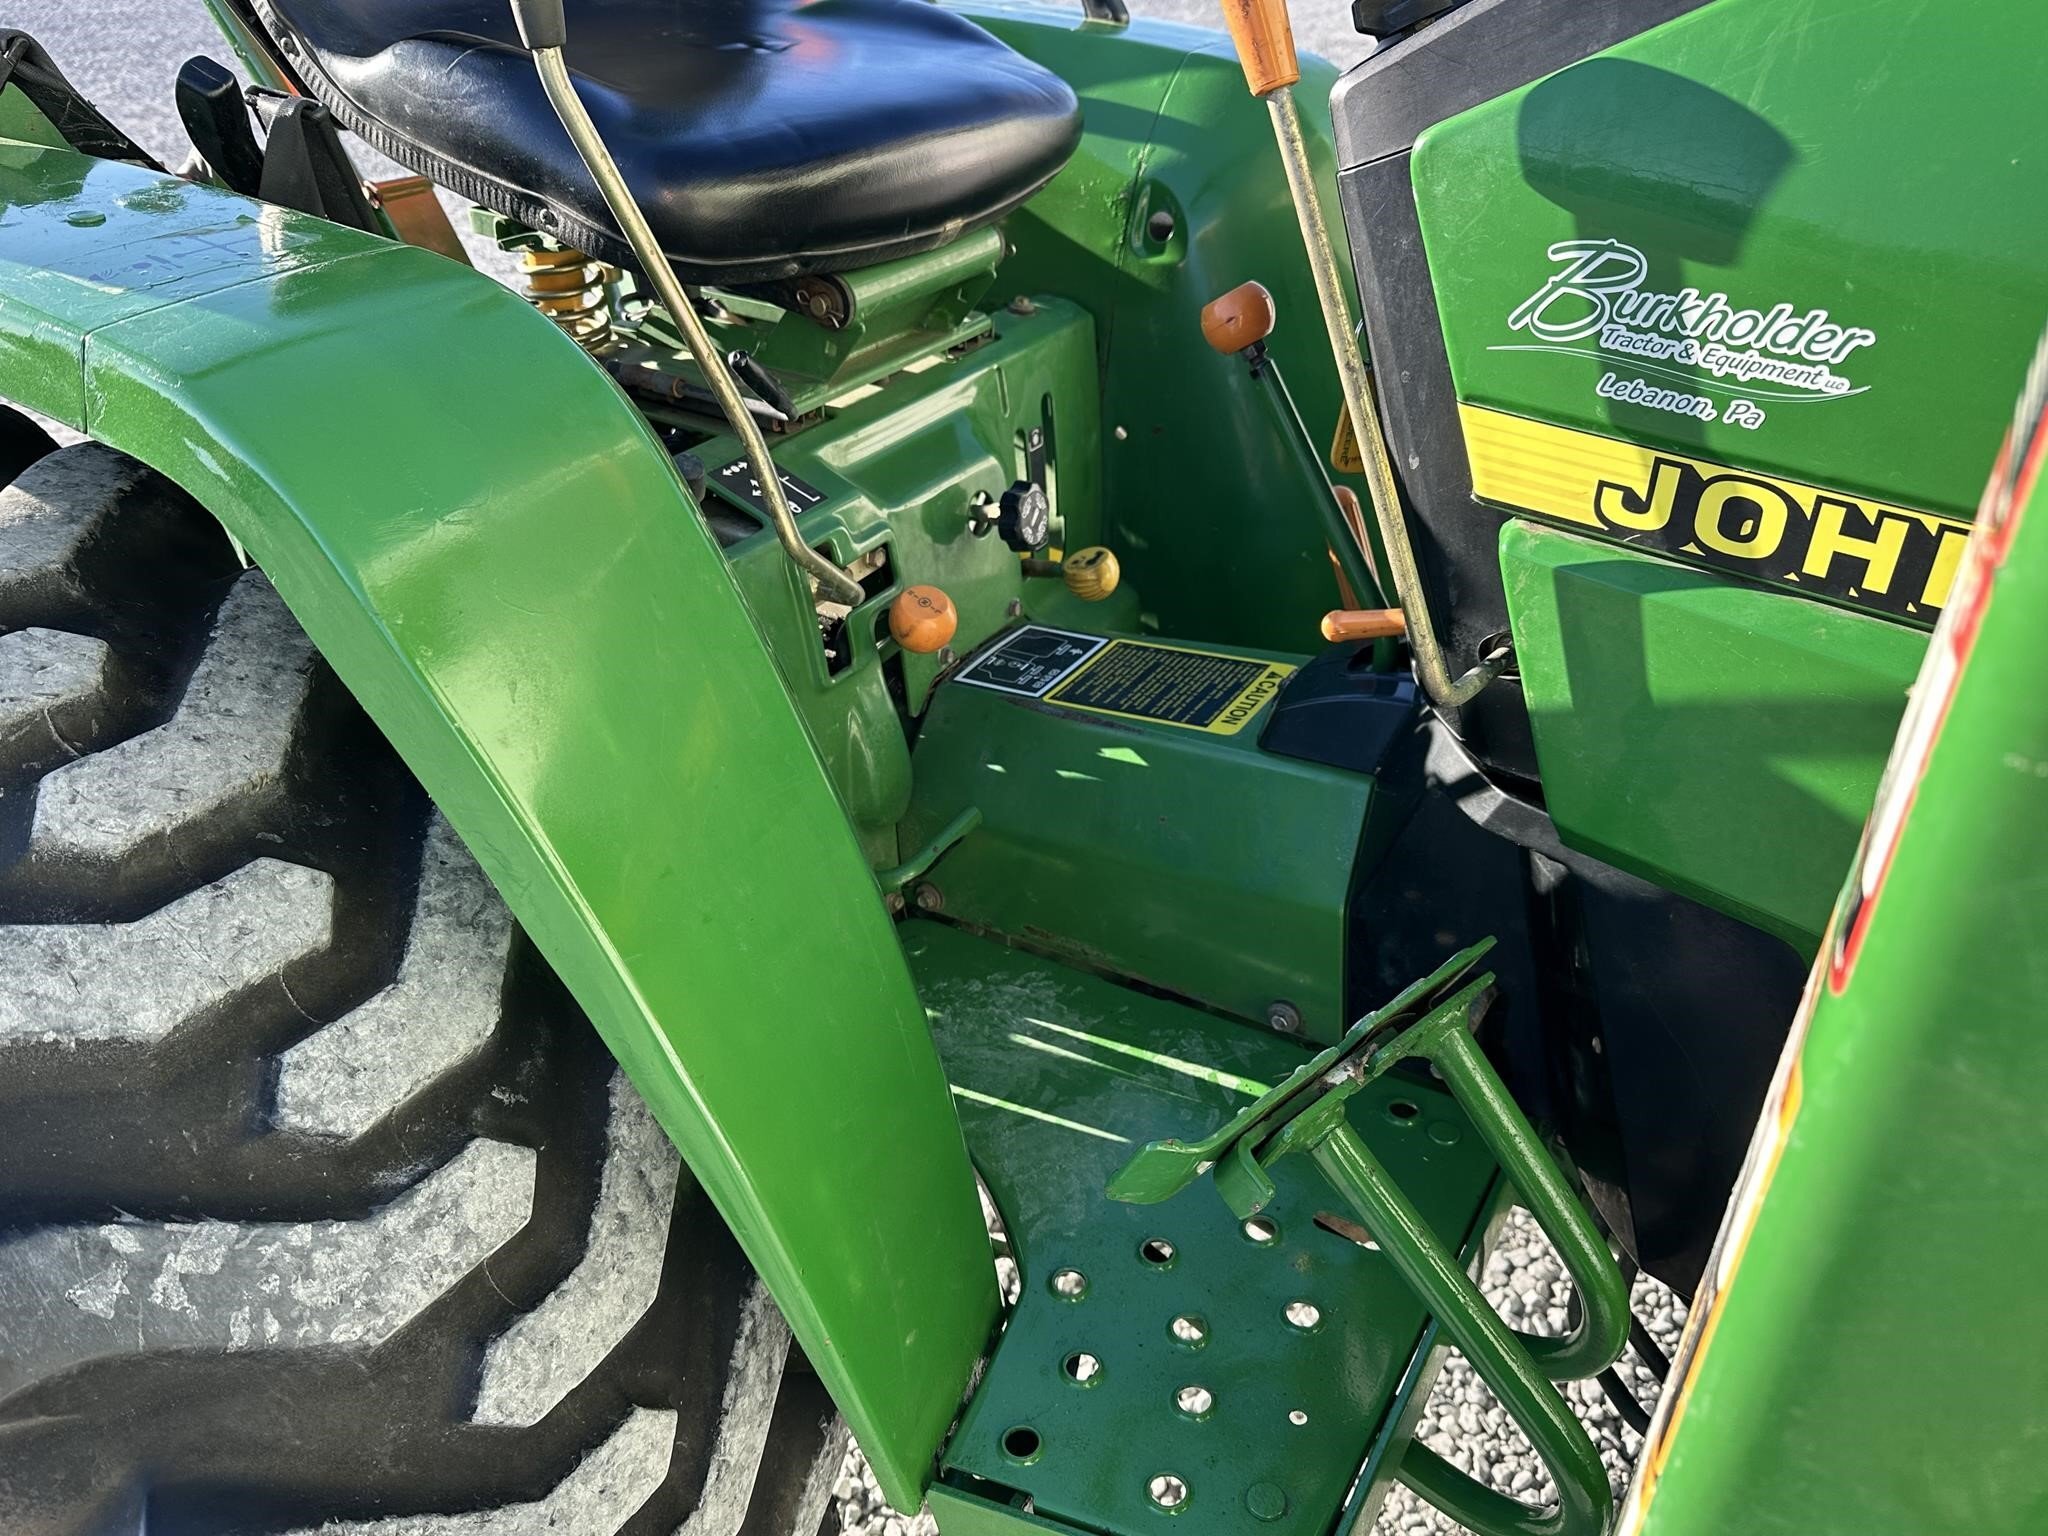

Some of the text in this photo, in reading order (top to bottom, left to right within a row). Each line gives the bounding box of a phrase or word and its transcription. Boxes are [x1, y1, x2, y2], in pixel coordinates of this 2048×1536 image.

[1508, 239, 1876, 366] Burkholder
[1601, 328, 1675, 358] Tractor
[1678, 341, 1696, 362] &
[1701, 346, 1826, 387] Equipment
[1598, 374, 1764, 428] Lebanon, Pa
[1221, 680, 1276, 725] CAUTION
